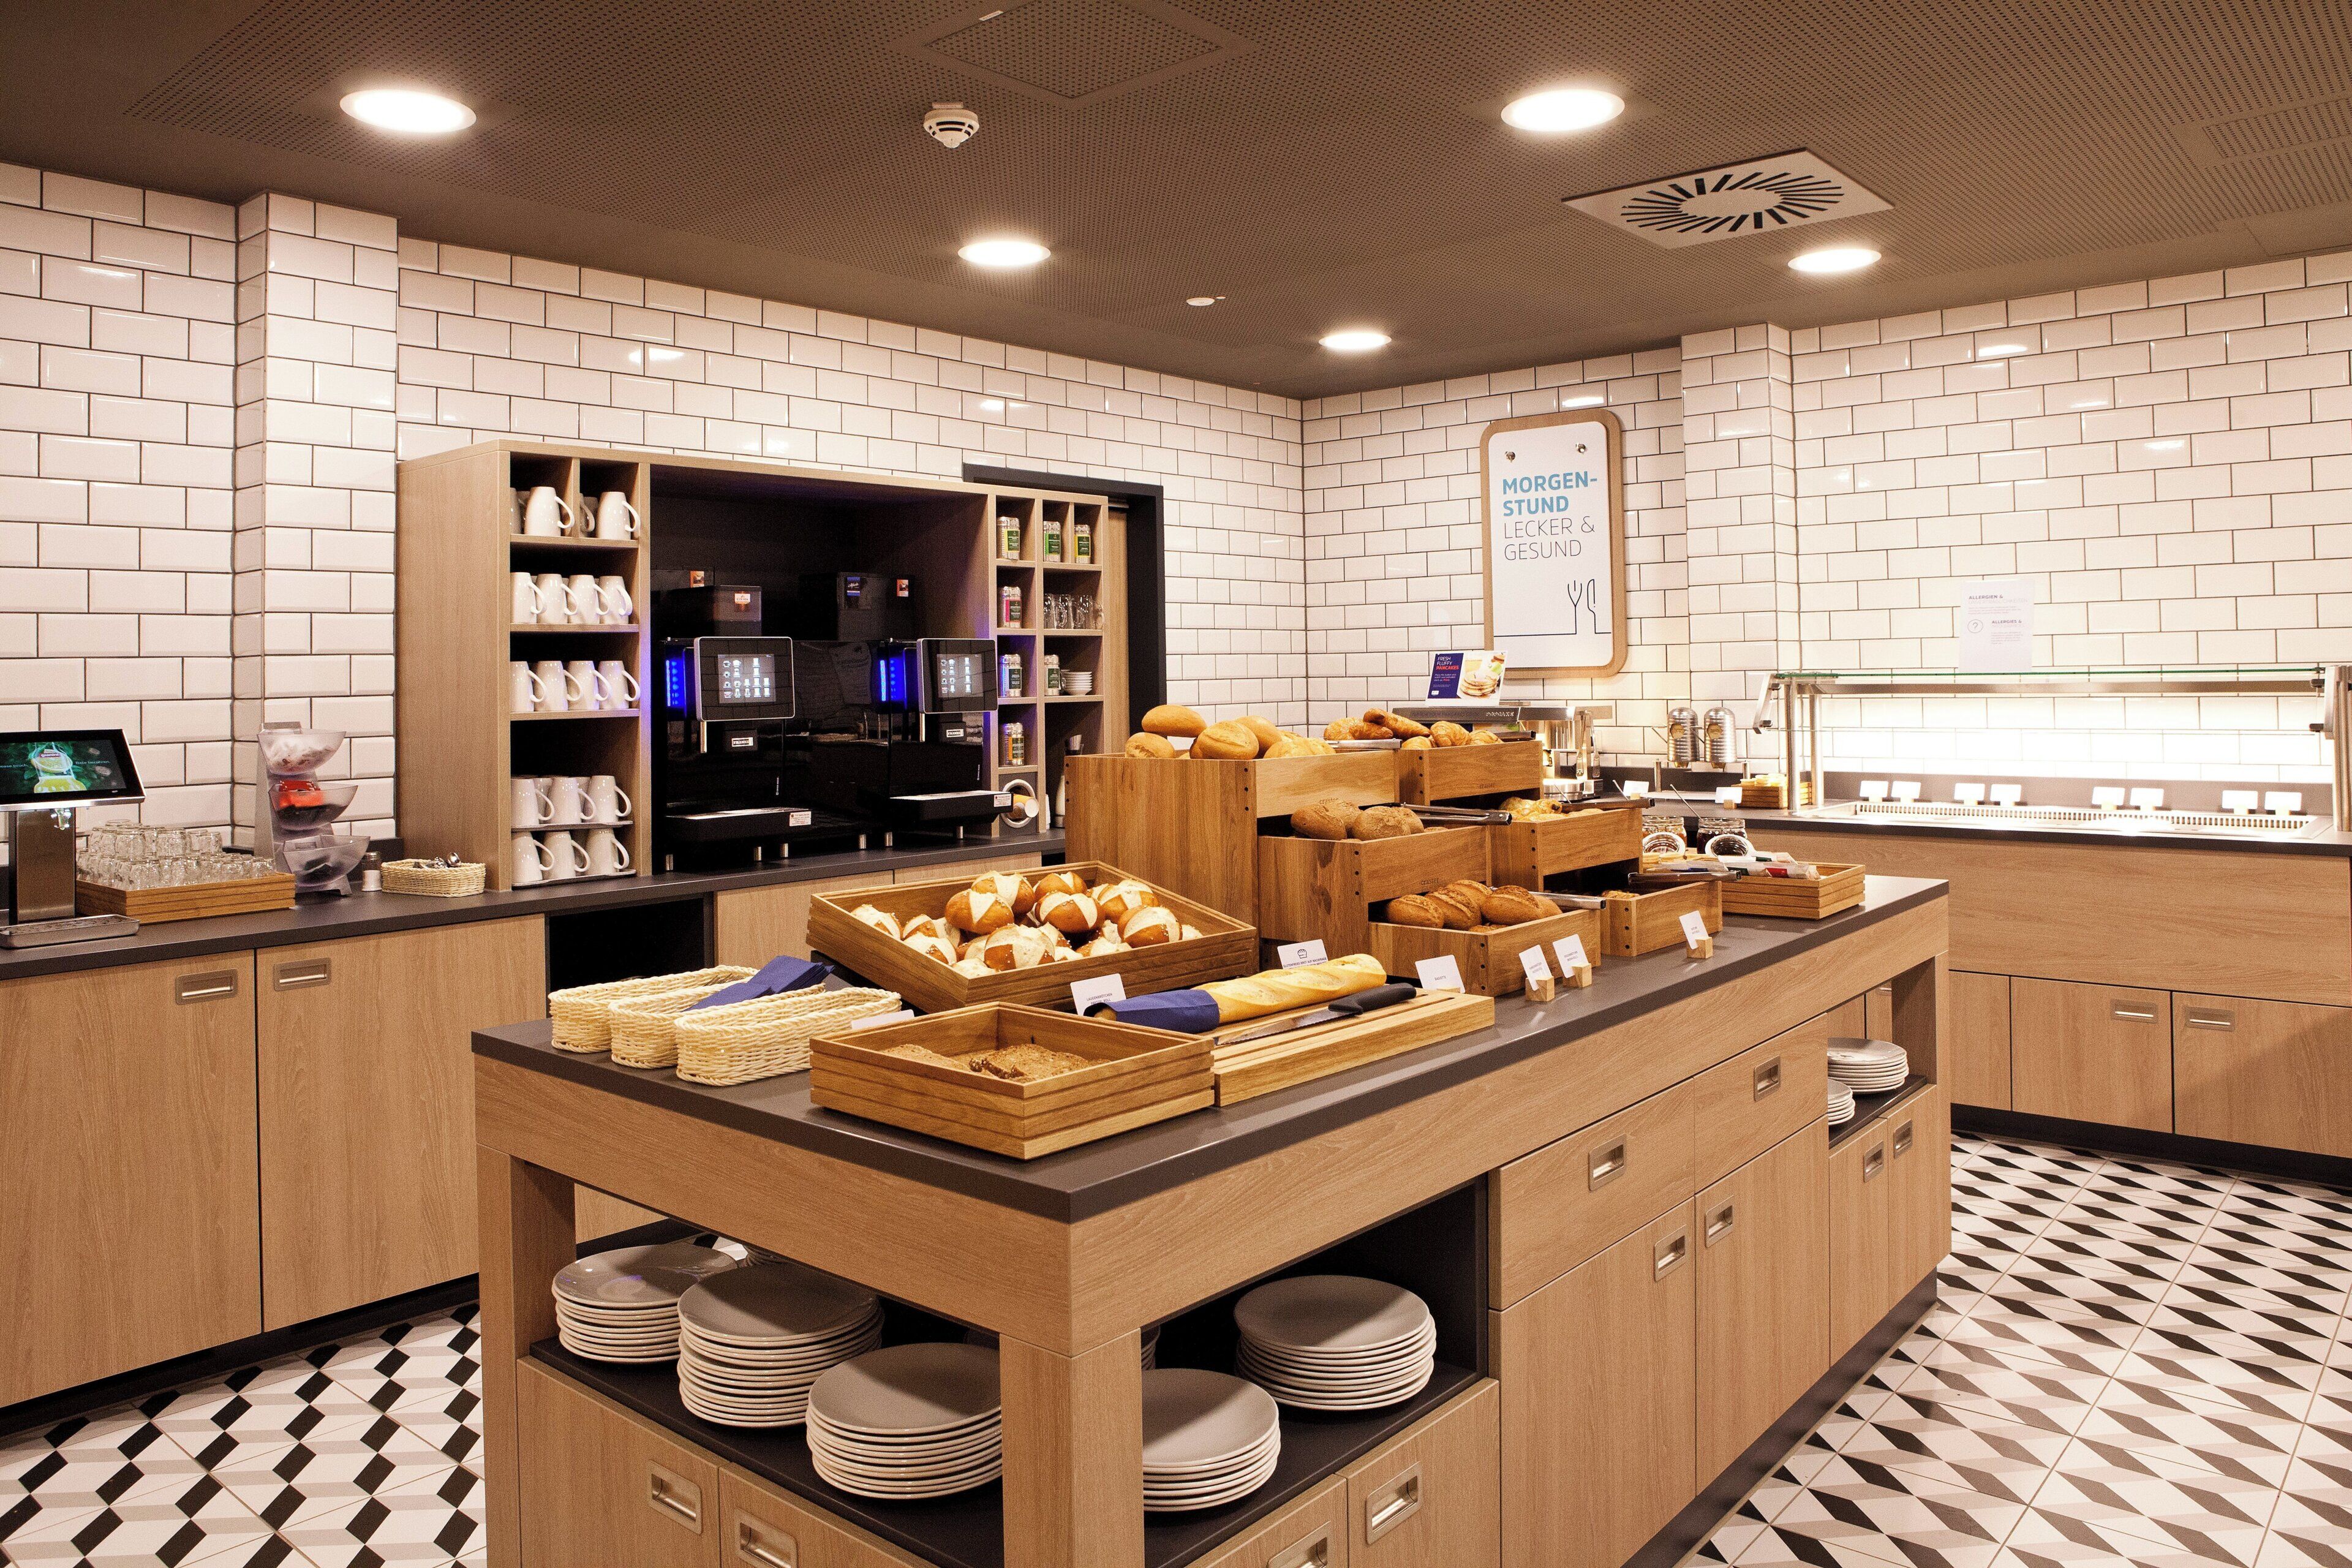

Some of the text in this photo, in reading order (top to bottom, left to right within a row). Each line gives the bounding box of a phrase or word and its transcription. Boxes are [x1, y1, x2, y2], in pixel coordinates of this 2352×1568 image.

[1502, 471, 1597, 494] MORGEN-
[1502, 496, 1569, 516] STUND
[1504, 516, 1595, 538] LECKER &
[1504, 540, 1581, 560] GESUND
